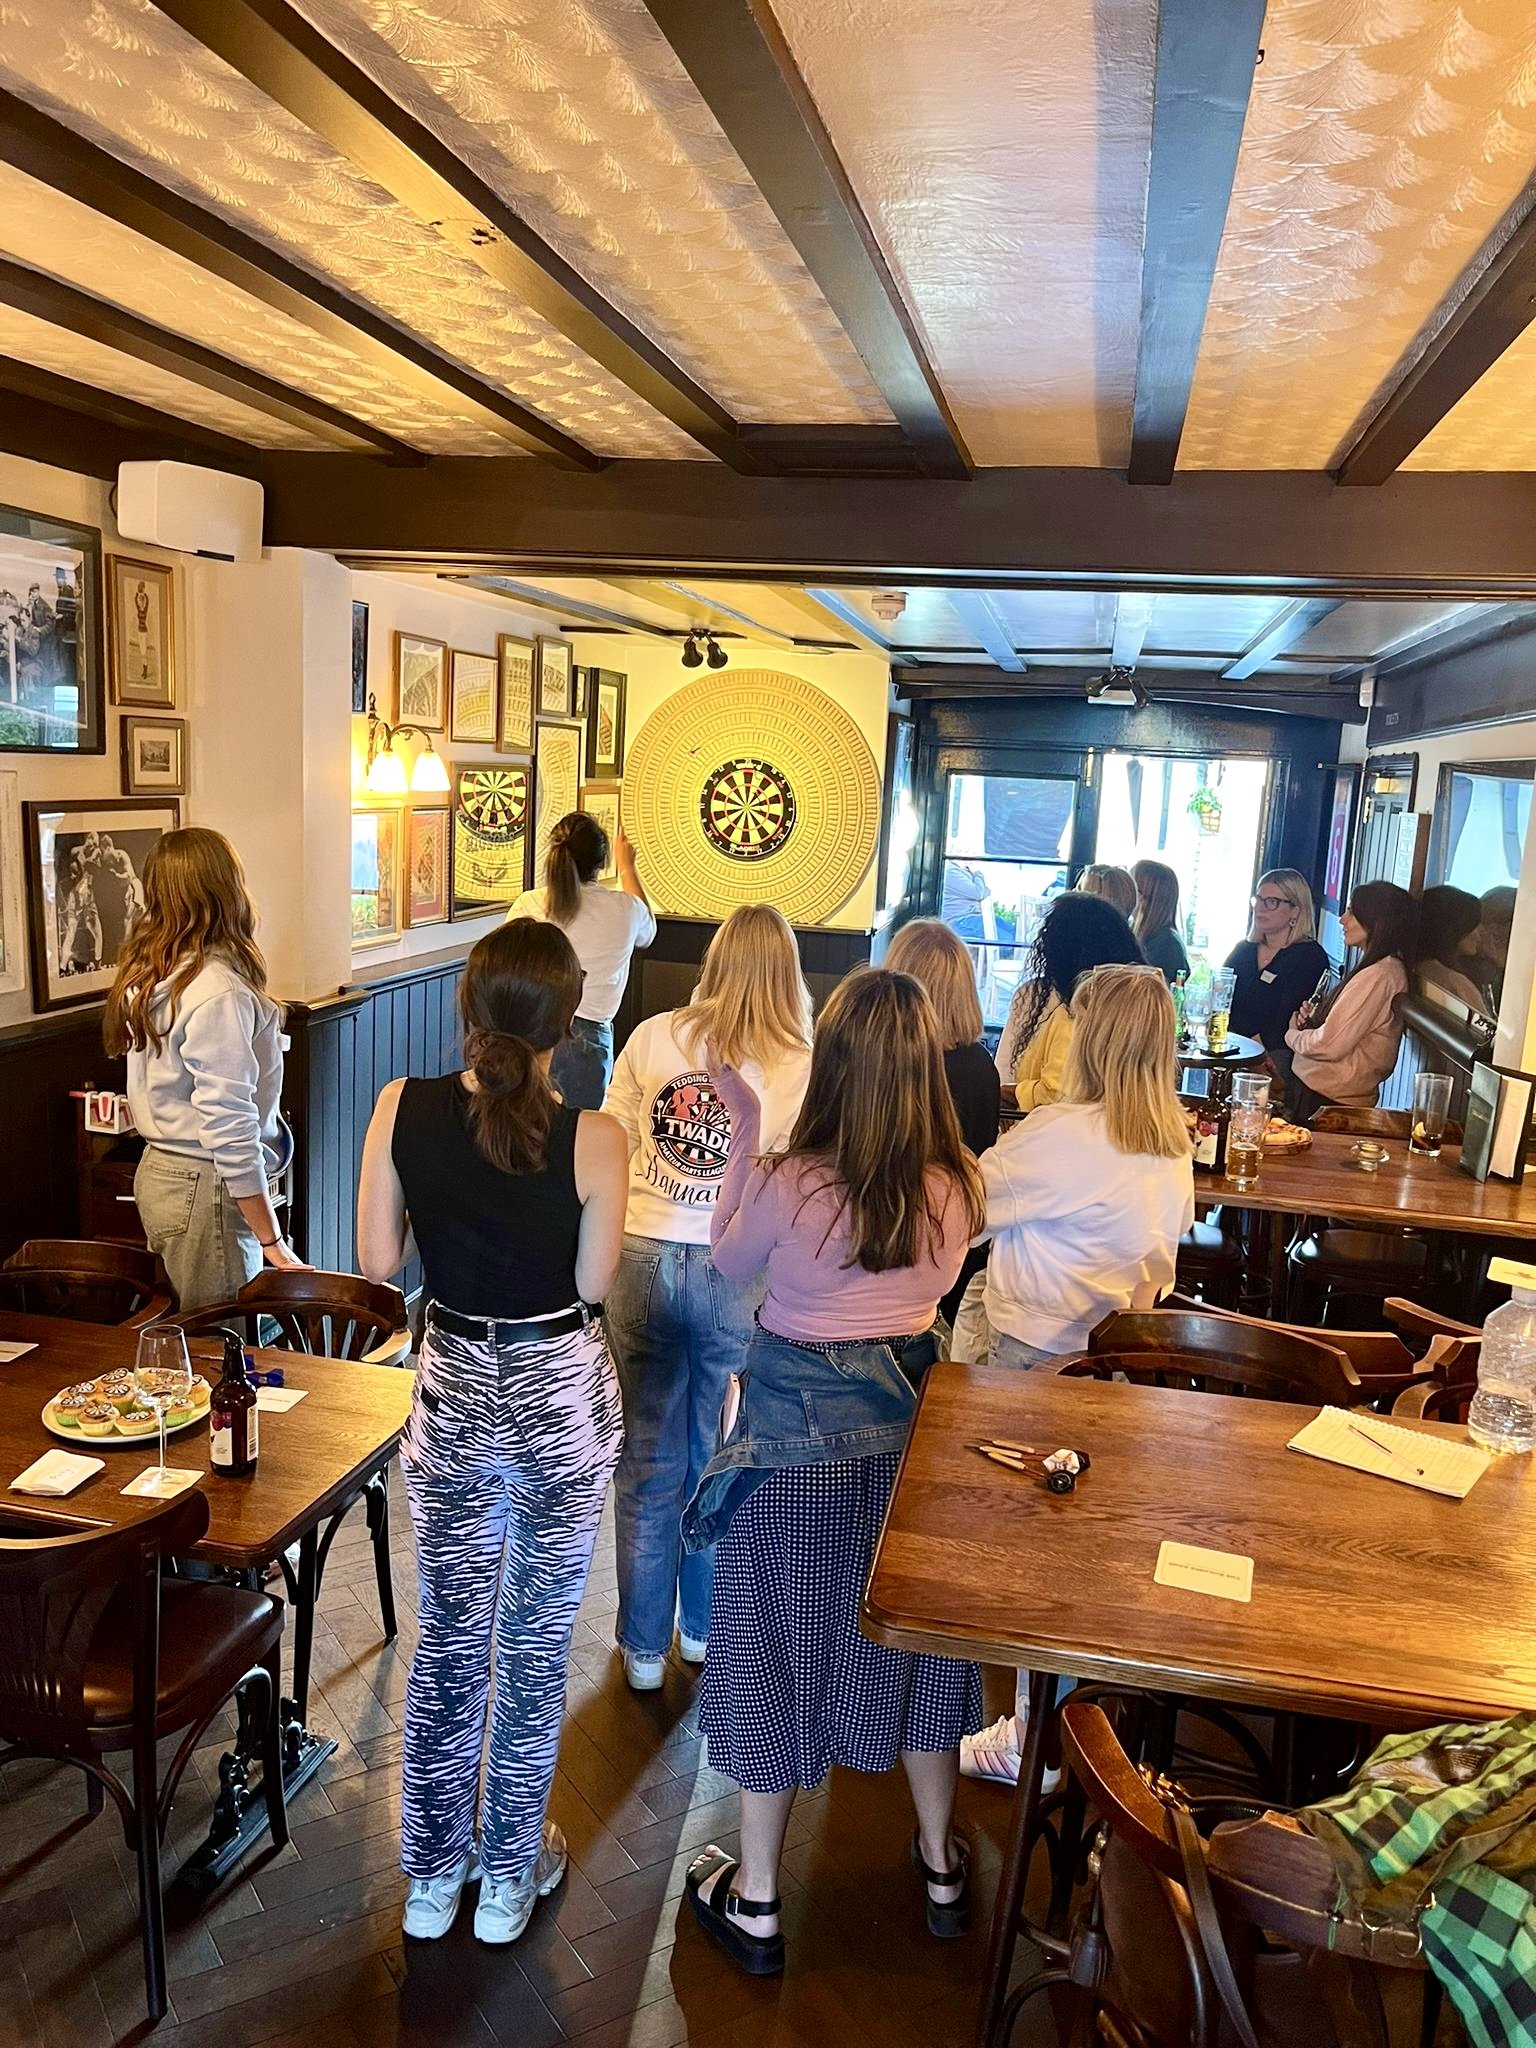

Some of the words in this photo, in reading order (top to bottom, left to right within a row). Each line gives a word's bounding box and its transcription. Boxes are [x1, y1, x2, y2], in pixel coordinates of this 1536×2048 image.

[670, 1074, 709, 1090] TEDDING
[659, 1141, 682, 1170] AMATEUR
[680, 1164, 702, 1177] DARTS
[702, 1164, 728, 1178] LEAGU
